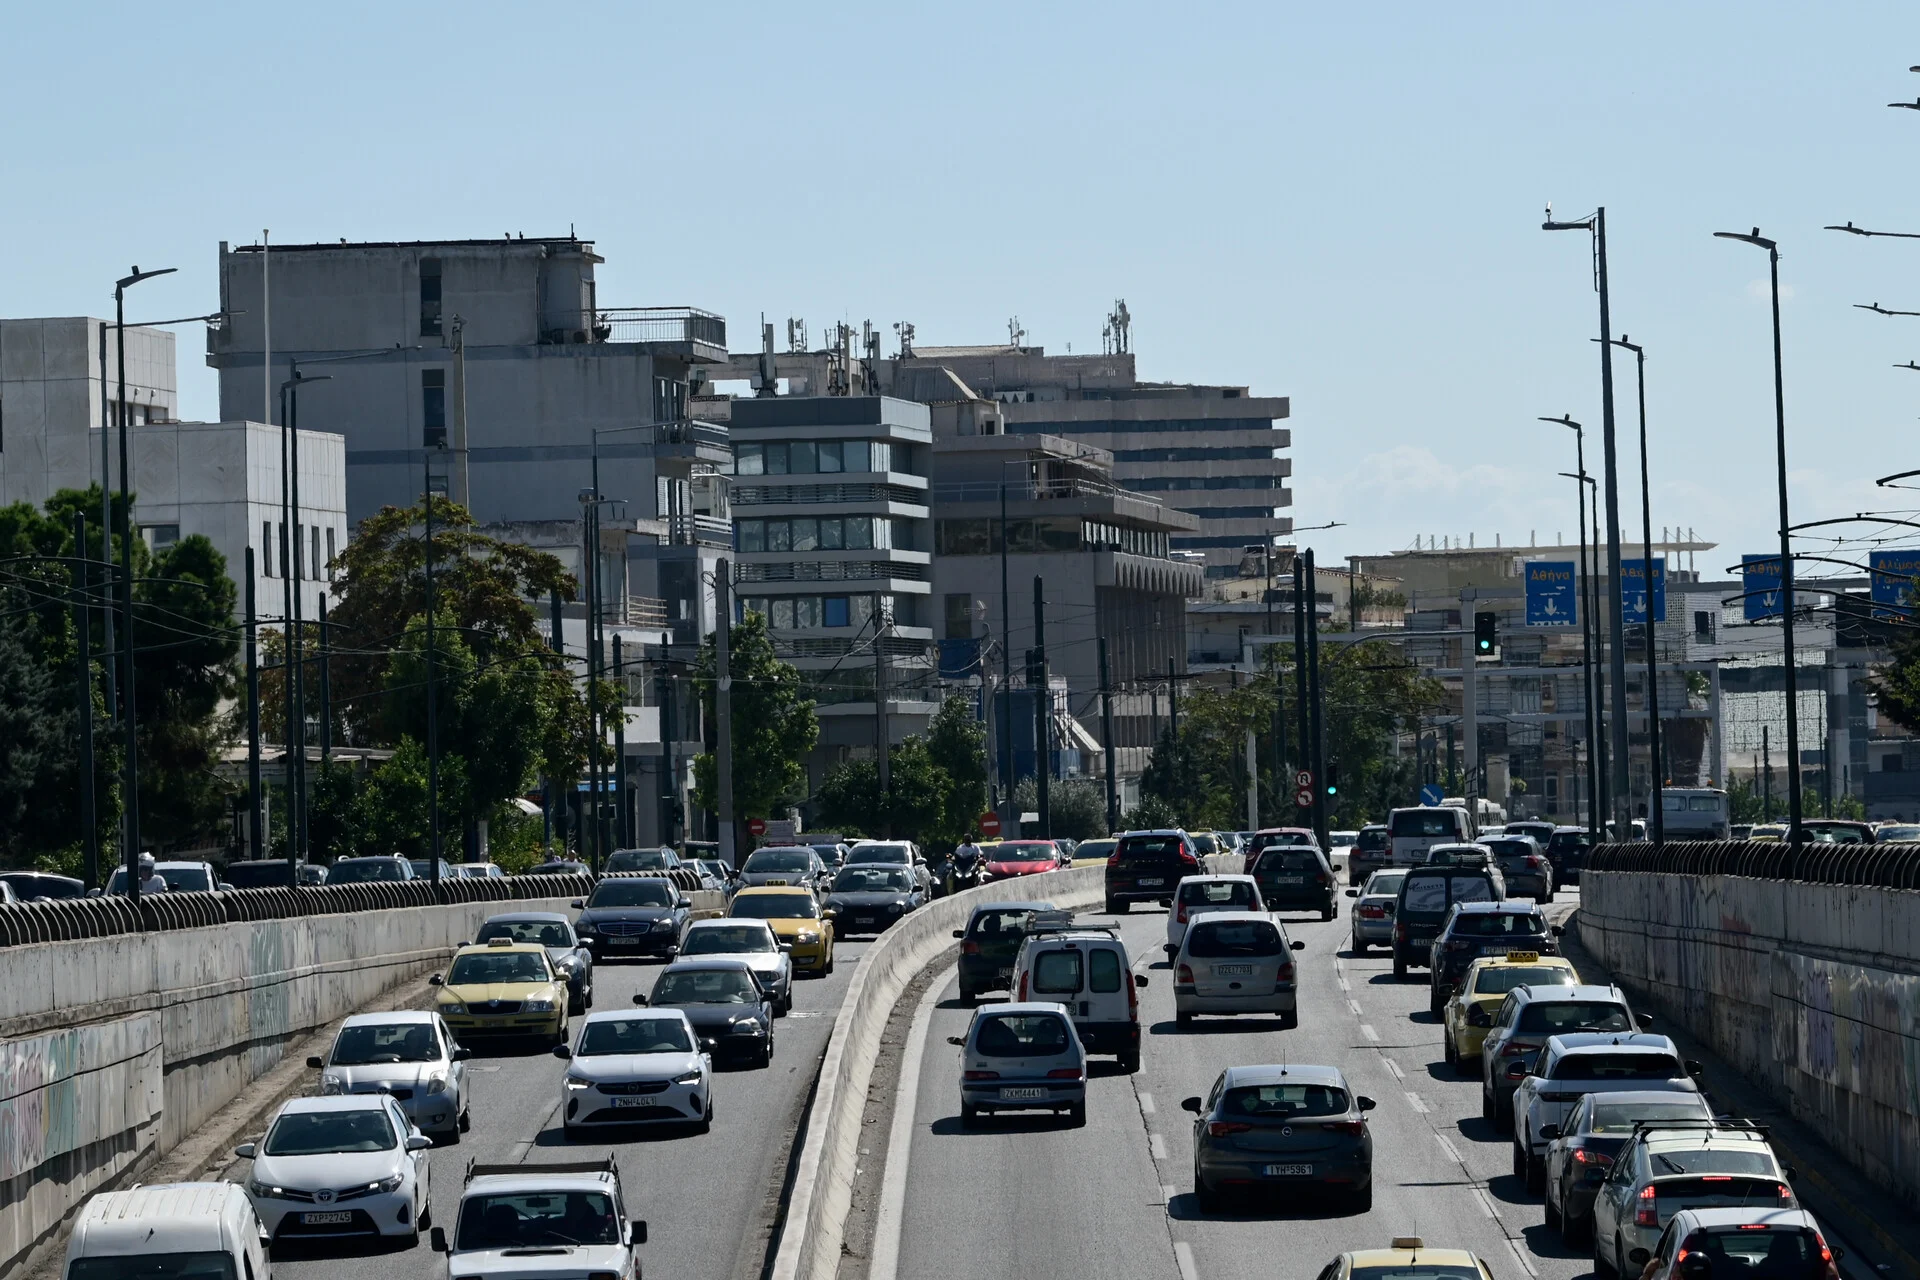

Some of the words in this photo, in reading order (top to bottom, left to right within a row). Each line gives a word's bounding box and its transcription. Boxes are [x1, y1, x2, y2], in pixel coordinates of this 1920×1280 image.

[1621, 567, 1659, 580] Αθήα
[1750, 561, 1782, 575] Αθήν
[1531, 569, 1571, 583] Αθήνα
